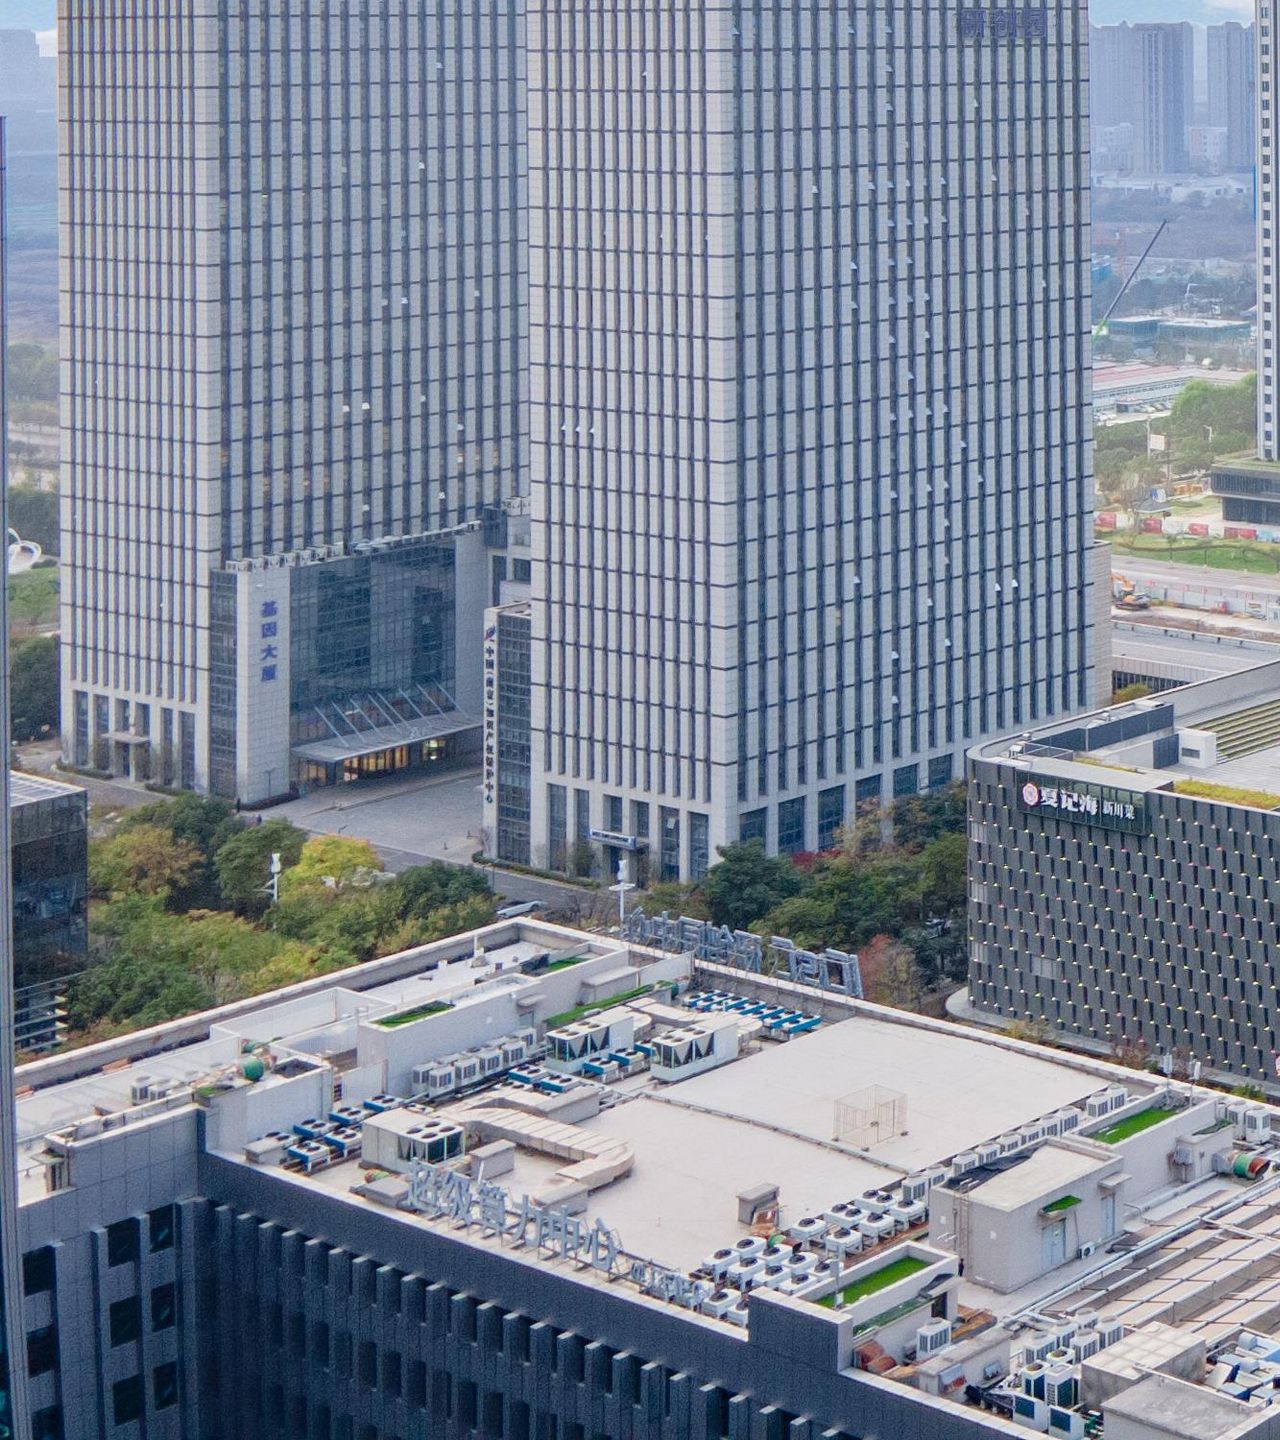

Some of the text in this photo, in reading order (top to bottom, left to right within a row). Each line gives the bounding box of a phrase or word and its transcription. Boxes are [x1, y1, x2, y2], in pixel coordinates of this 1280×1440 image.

[961, 8, 1047, 38] 研创园
[260, 600, 278, 682] 基因大厦
